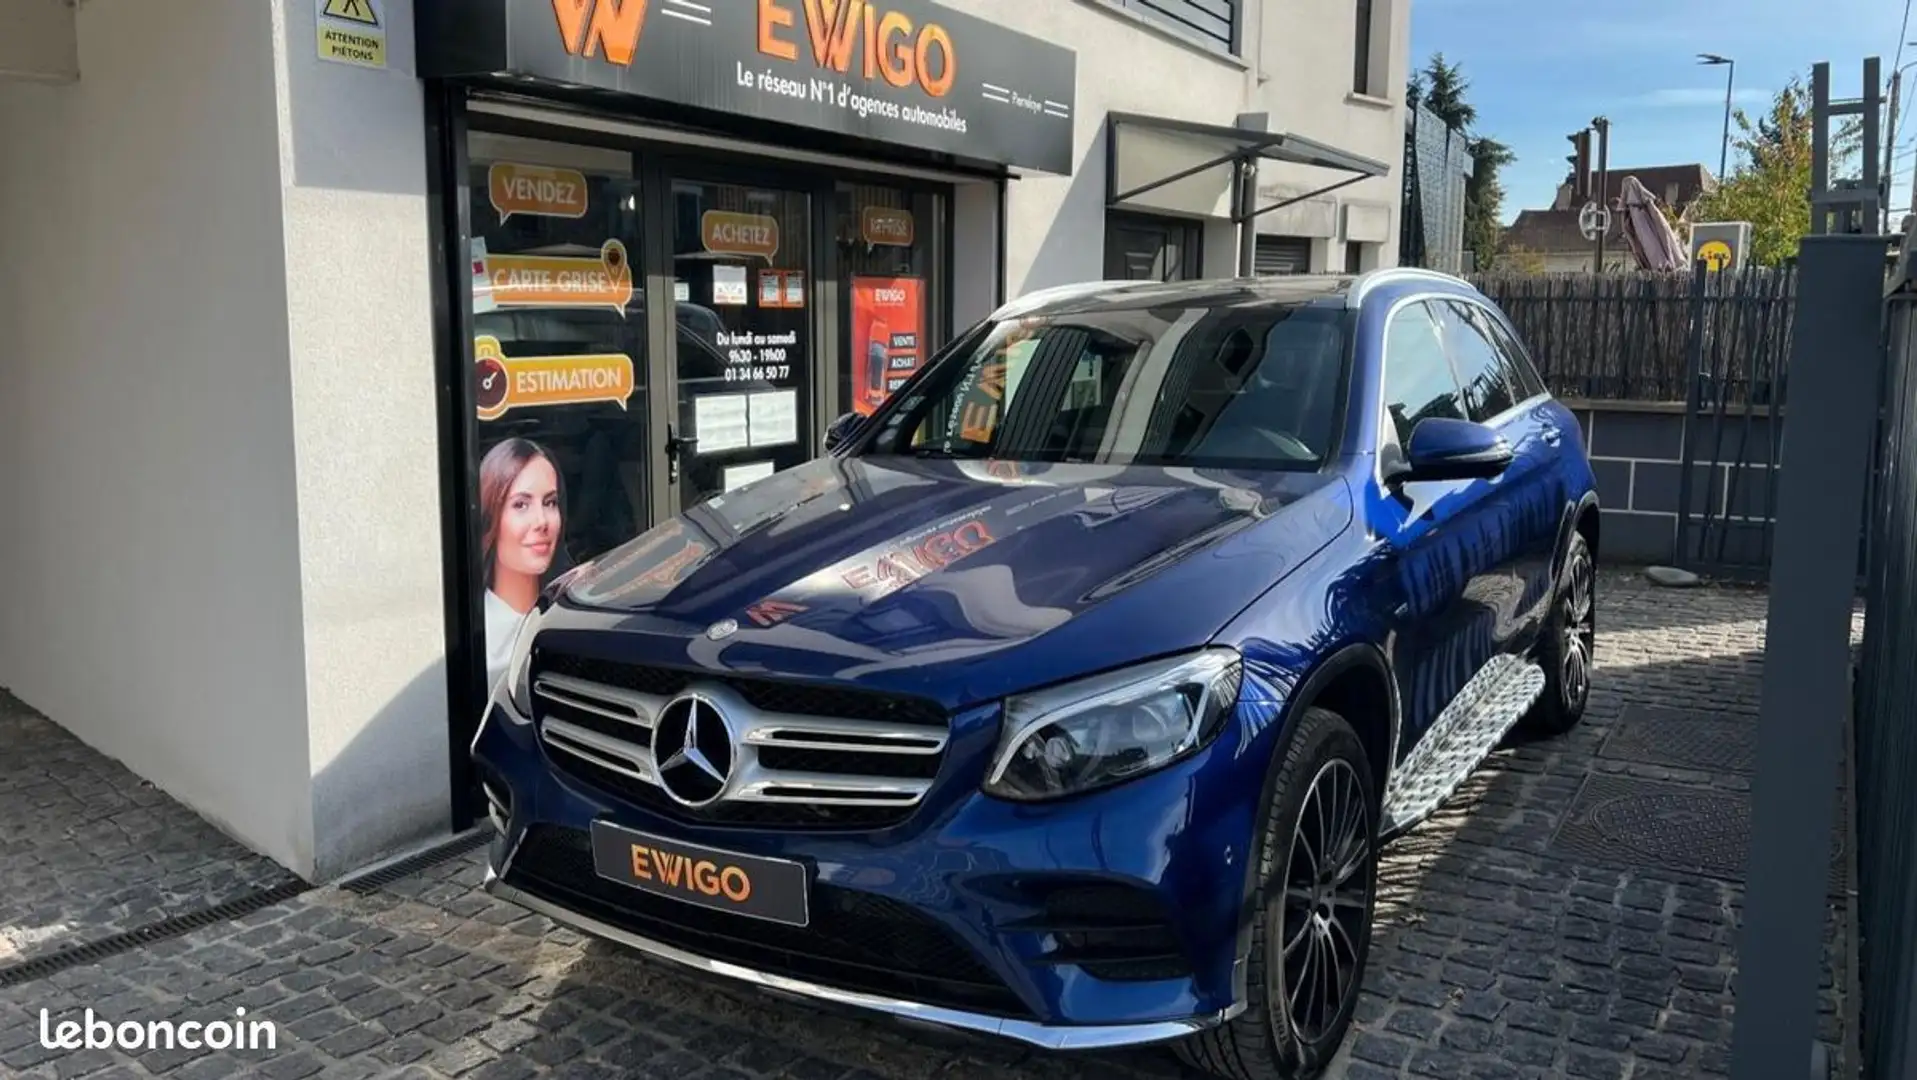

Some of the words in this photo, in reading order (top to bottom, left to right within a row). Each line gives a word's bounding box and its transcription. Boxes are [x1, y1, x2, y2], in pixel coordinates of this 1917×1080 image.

[325, 30, 379, 49] ATTENTION
[757, 0, 957, 97] EWIGO
[737, 61, 754, 87] Le
[758, 69, 806, 98] réseau
[902, 103, 967, 134] automobiles
[503, 176, 577, 205] VENDEZ
[711, 222, 772, 246] ACHETEZ
[493, 267, 550, 292] CARTE
[556, 270, 607, 292] GRISE
[716, 332, 730, 345] Du
[731, 330, 753, 345] lundi
[754, 335, 766, 345] au
[767, 330, 796, 344] samedi
[728, 349, 752, 364] 9h30
[760, 347, 786, 362] 19h00
[892, 357, 915, 369] ACHAT
[516, 366, 621, 393] ESTIMATION
[725, 367, 737, 382] 01
[739, 367, 751, 381] 34
[752, 366, 765, 380] 66
[766, 365, 777, 379] 50
[778, 365, 790, 379] 77
[631, 843, 750, 902] EWIGO
